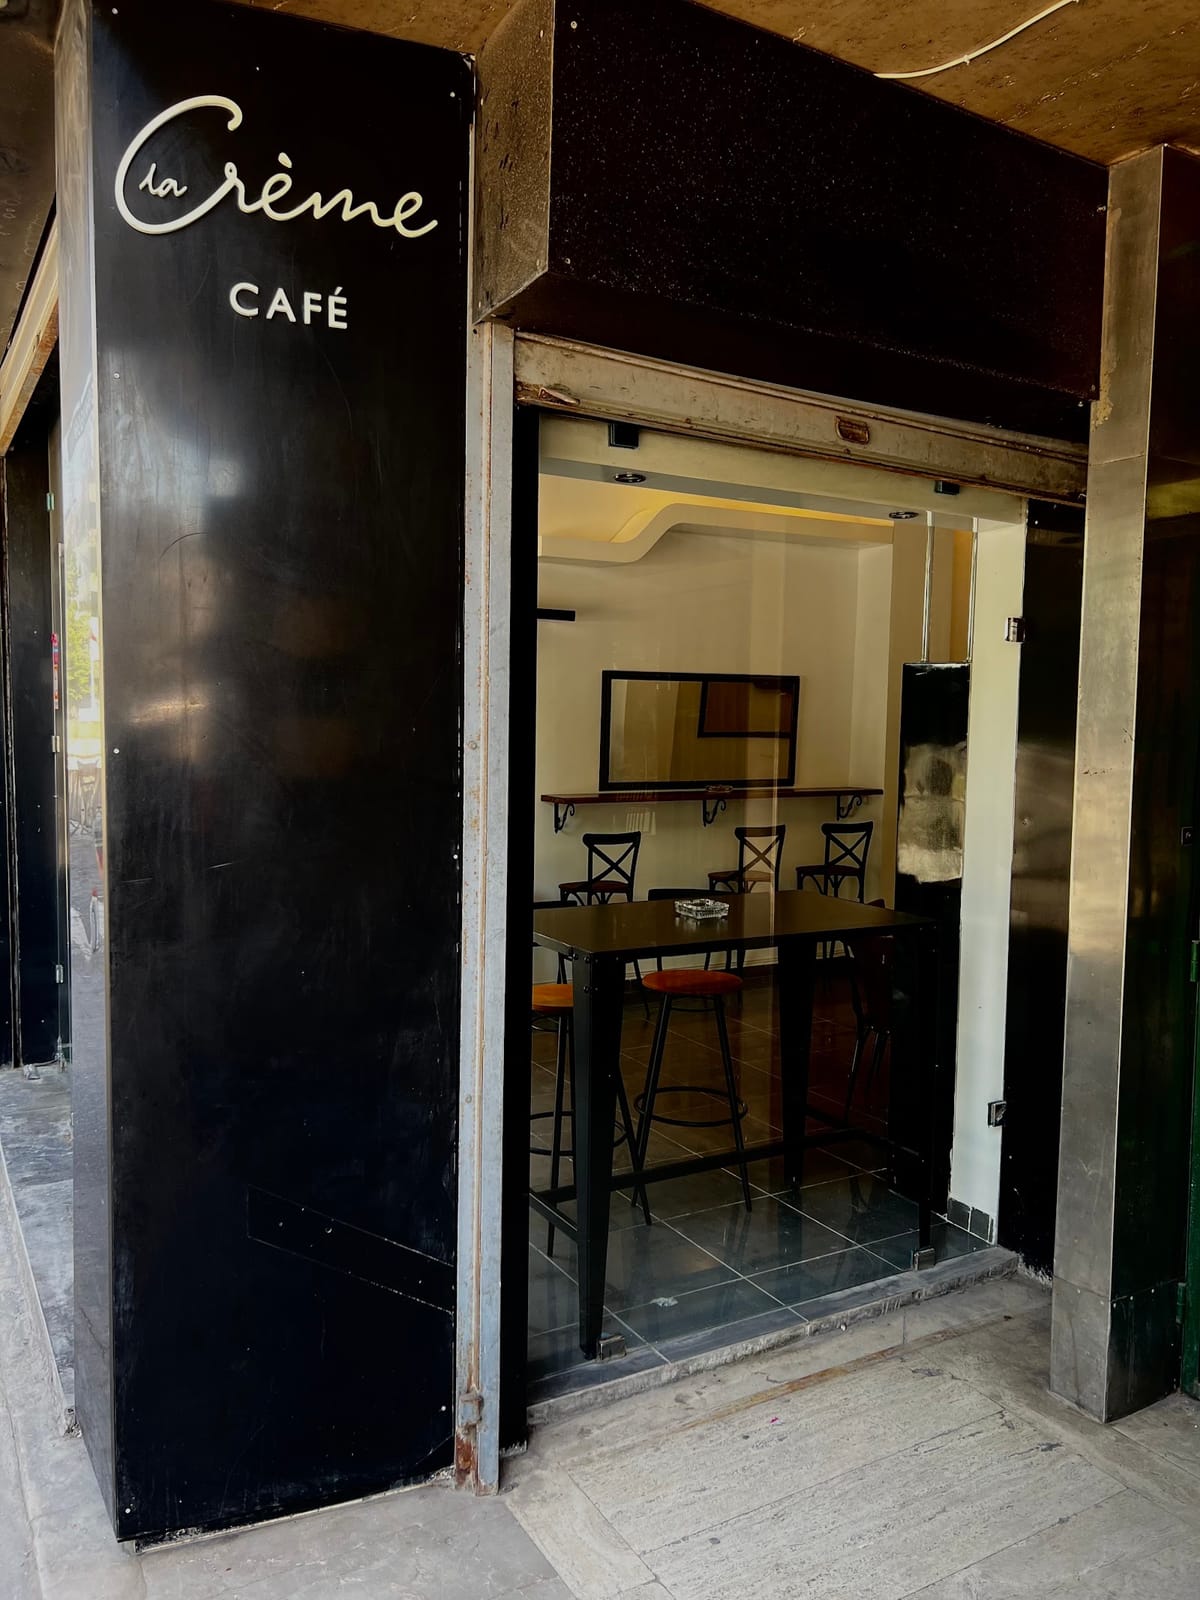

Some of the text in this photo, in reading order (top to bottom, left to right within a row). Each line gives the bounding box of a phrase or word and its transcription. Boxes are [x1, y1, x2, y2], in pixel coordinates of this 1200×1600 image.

[114, 95, 438, 238] la Crème
[229, 282, 348, 330] CAFÉ
